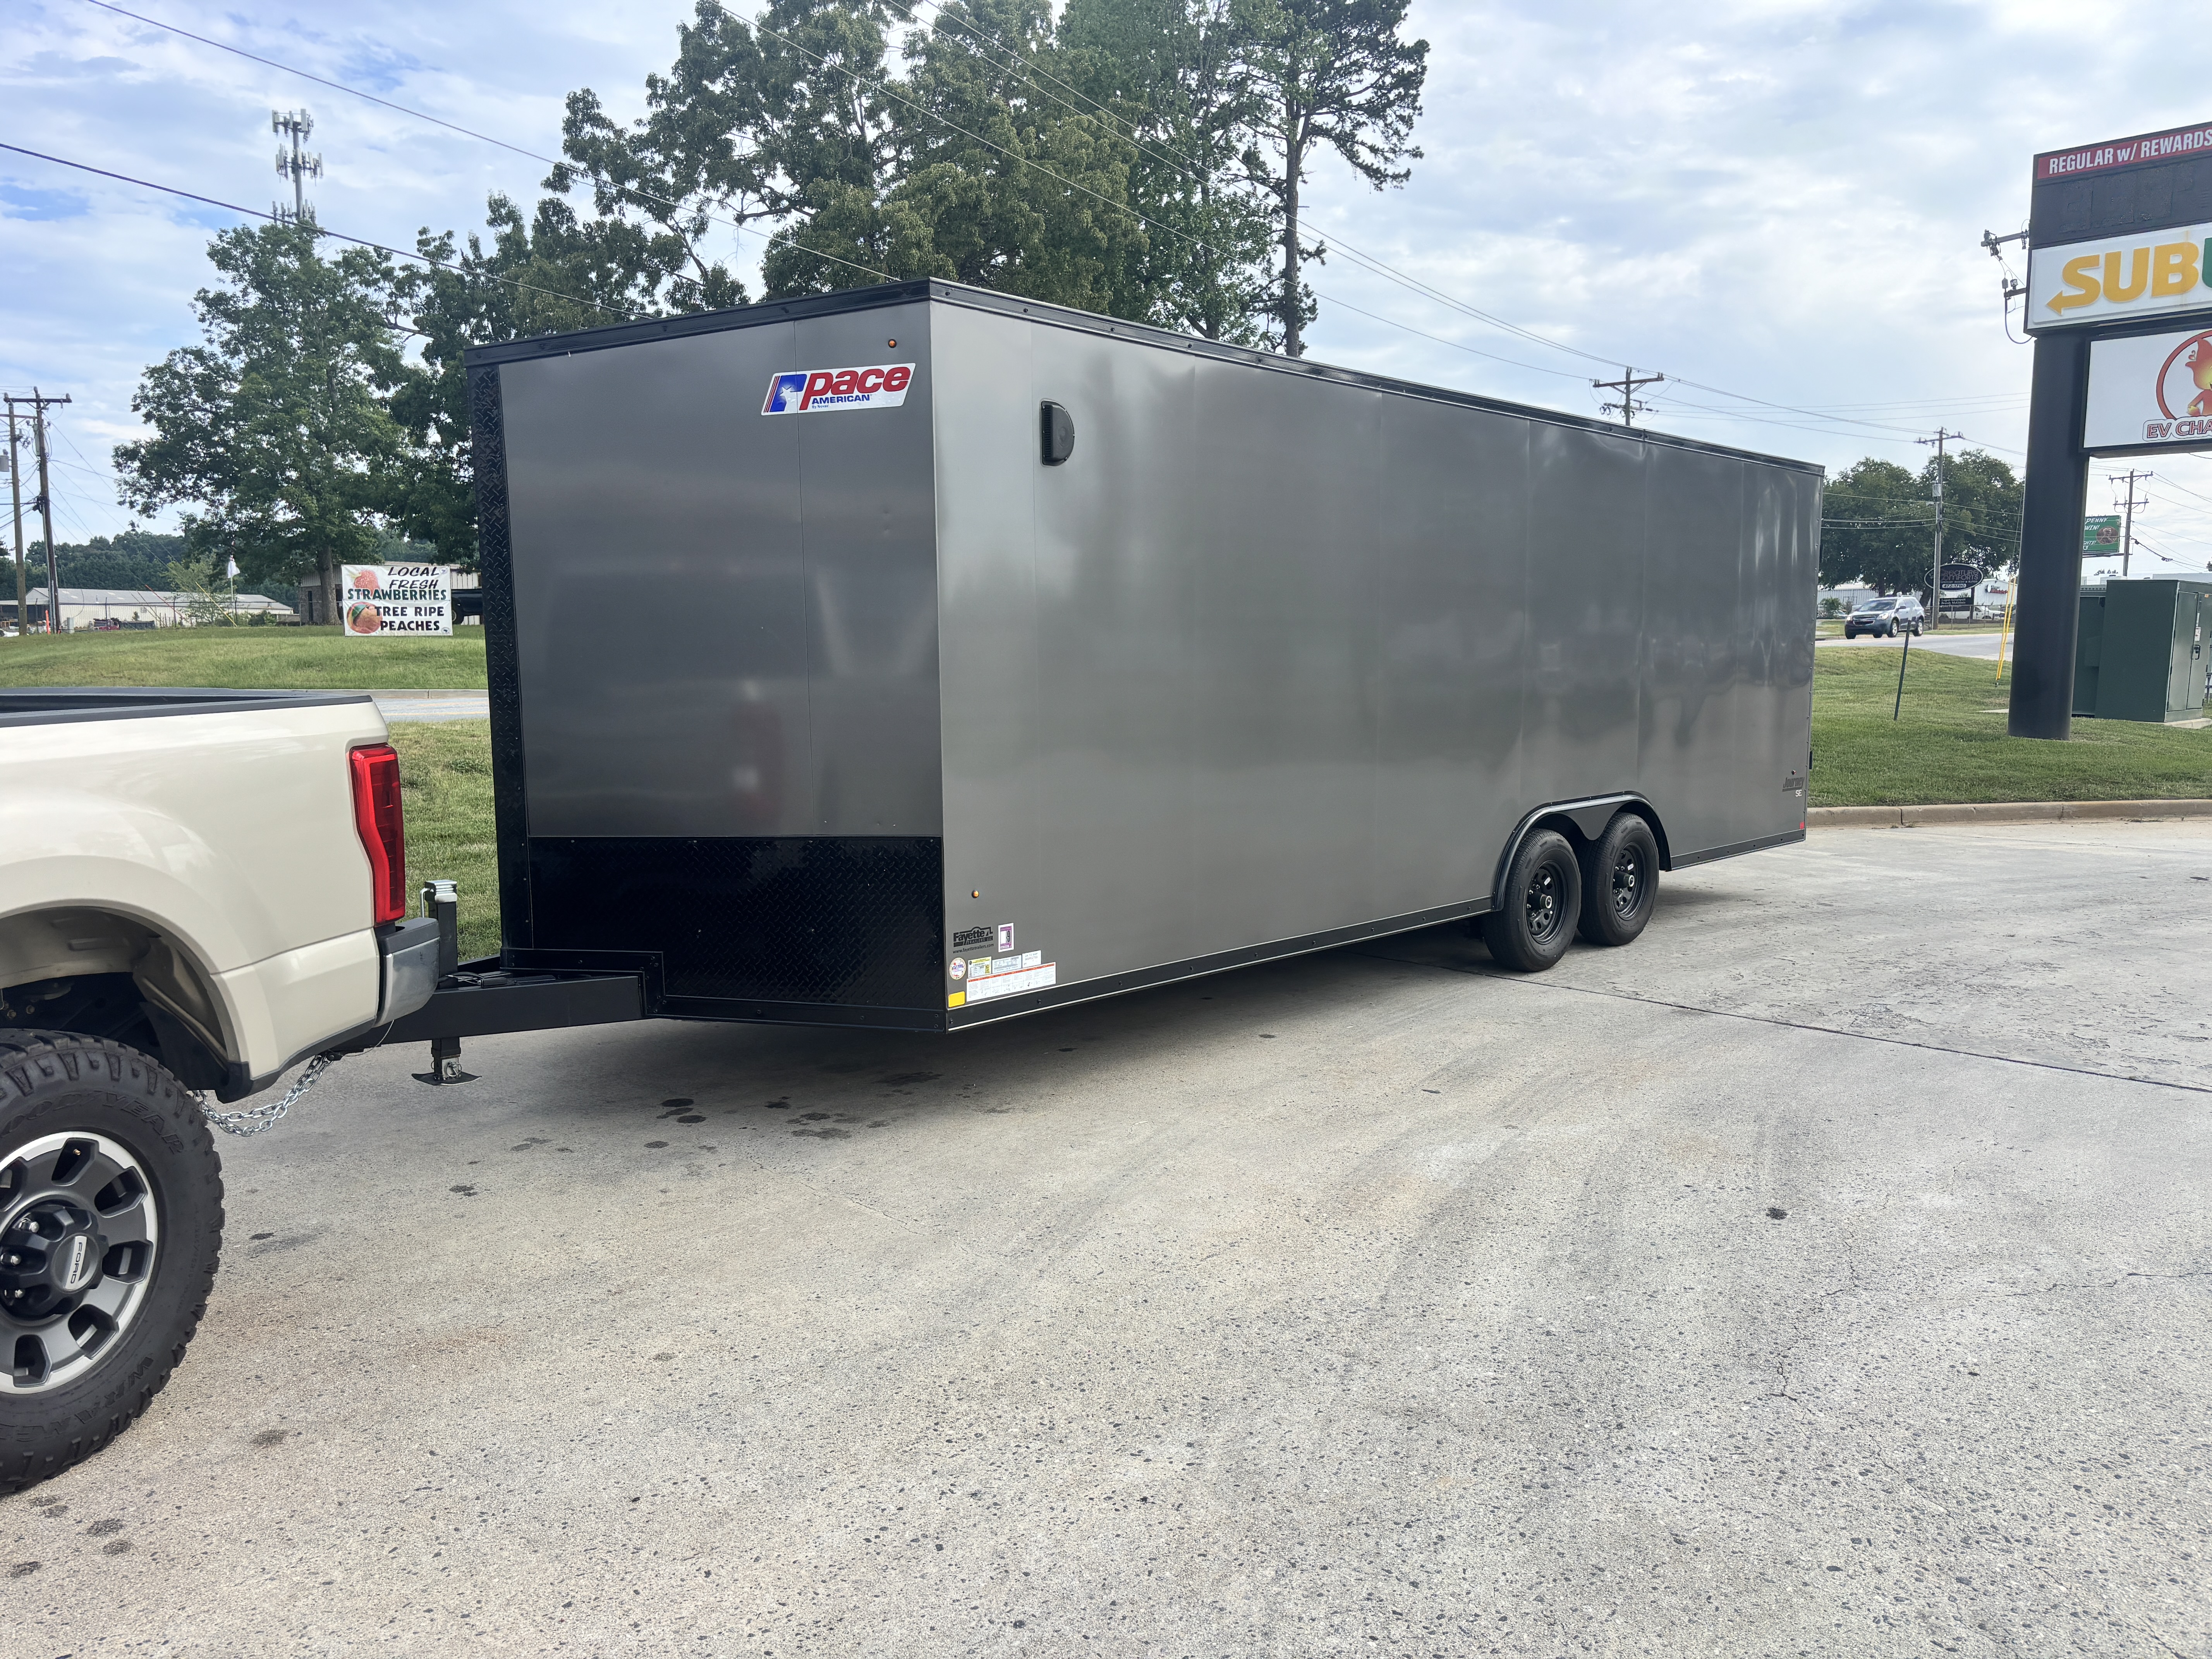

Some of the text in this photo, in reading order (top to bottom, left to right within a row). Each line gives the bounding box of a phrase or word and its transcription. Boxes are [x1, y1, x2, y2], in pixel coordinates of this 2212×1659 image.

[2049, 129, 2212, 174] REGULAR w/ REWARDS
[2046, 237, 2212, 316] SUB
[799, 366, 911, 410] pace
[812, 394, 870, 404] AMERICAN
[2147, 422, 2172, 438] EV
[388, 567, 440, 577] LOCAL
[389, 579, 439, 589] FRESH
[348, 589, 447, 600] STRAWBERRIES
[375, 606, 444, 617] TREE RIPE
[380, 620, 440, 631] PEACHES
[953, 929, 985, 945] Fayette
[70, 1242, 82, 1284] FORD
